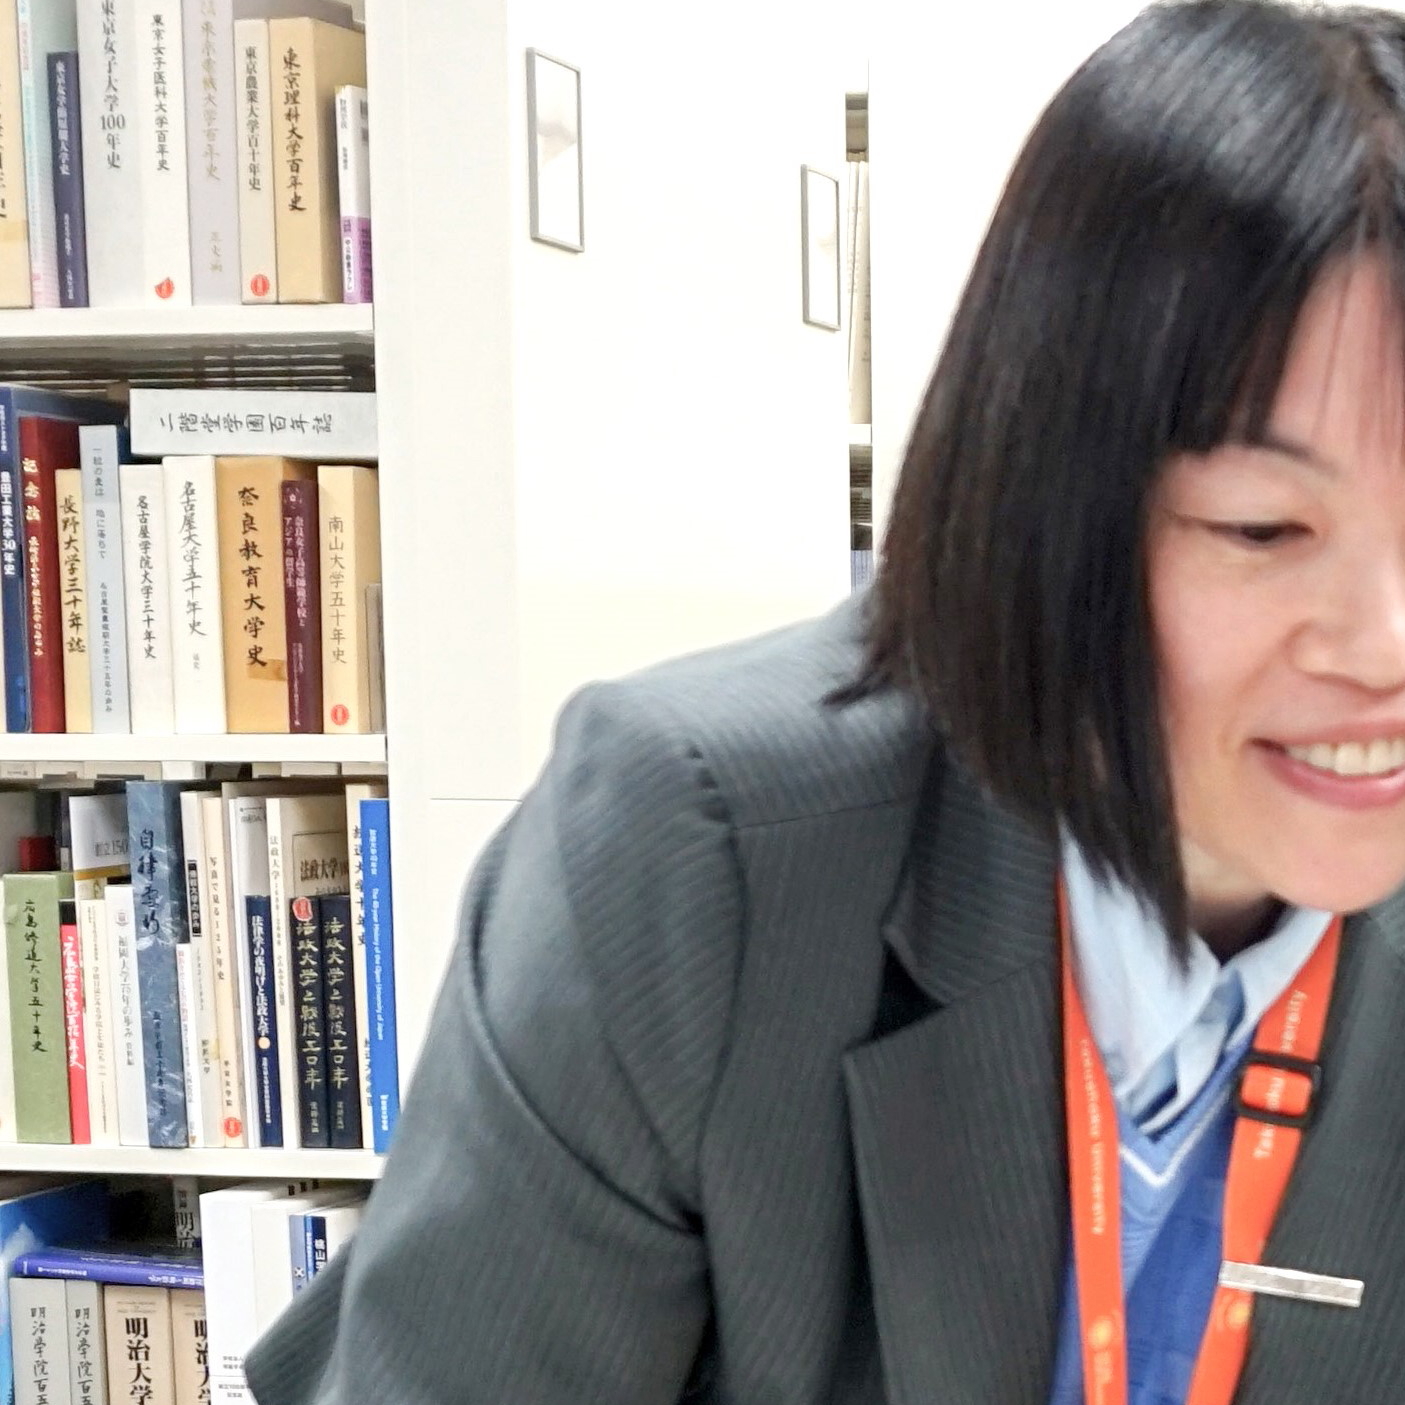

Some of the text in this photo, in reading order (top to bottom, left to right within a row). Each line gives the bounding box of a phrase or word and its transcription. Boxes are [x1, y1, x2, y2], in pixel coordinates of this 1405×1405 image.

[283, 47, 306, 212] 東京理科大学百年史
[59, 495, 86, 653] 長野大学三十年誌
[136, 496, 156, 660] 名古屋学院大学三十年史
[179, 480, 207, 637] 名古屋大学五十年史
[238, 486, 267, 668] 奈良教育大学史
[327, 516, 347, 664] 南山大学五十年史
